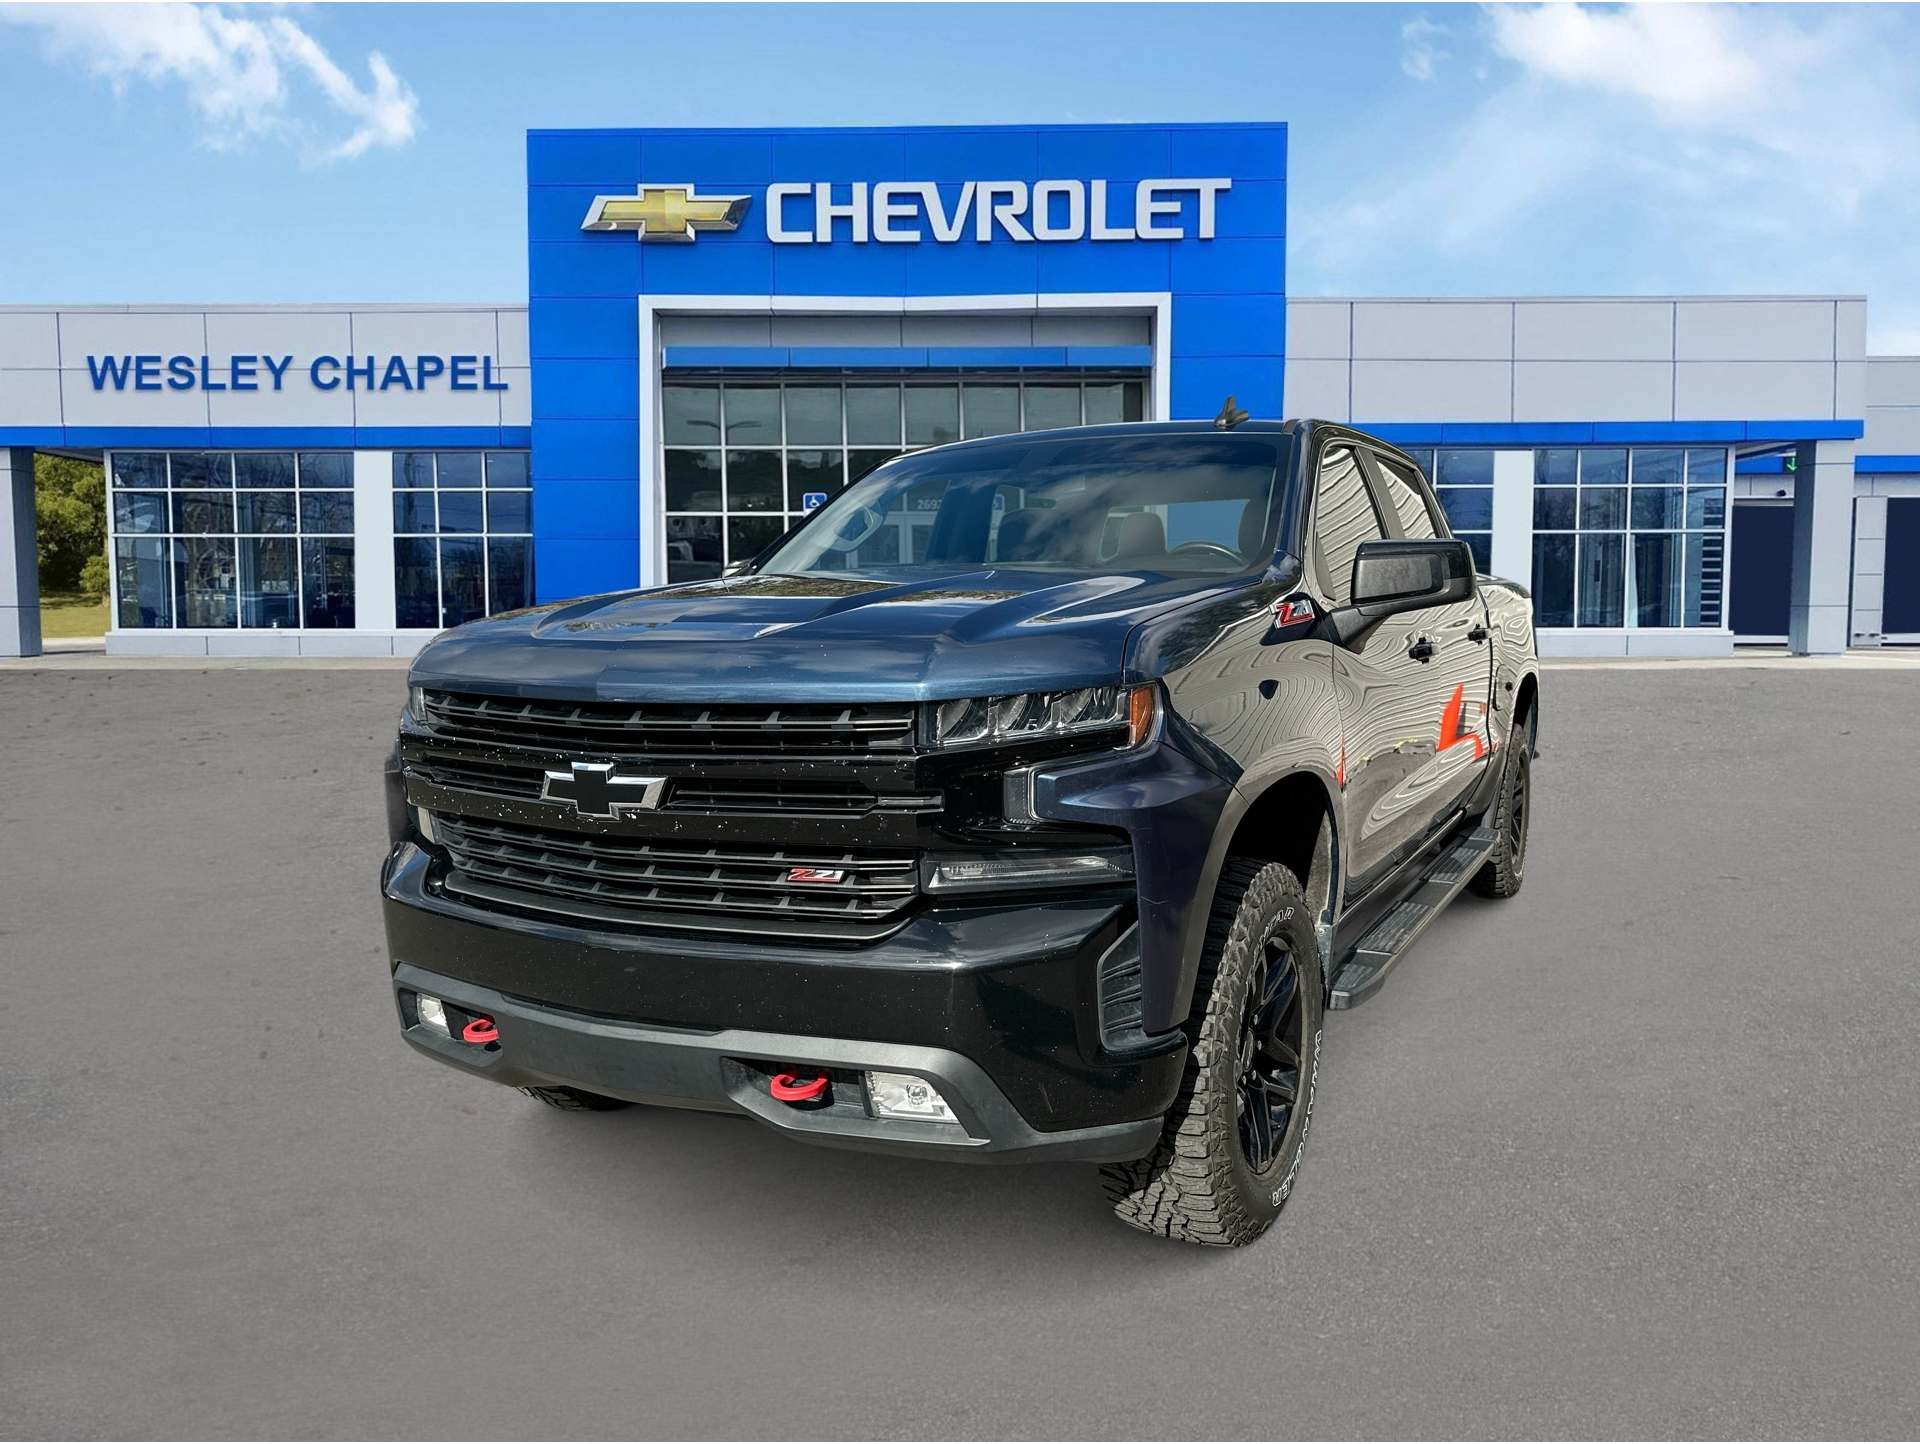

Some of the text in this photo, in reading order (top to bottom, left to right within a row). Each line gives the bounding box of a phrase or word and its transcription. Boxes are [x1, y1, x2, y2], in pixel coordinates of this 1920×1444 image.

[766, 178, 1232, 244] CHEVROLET
[87, 354, 509, 391] WESLEY CHAPEL
